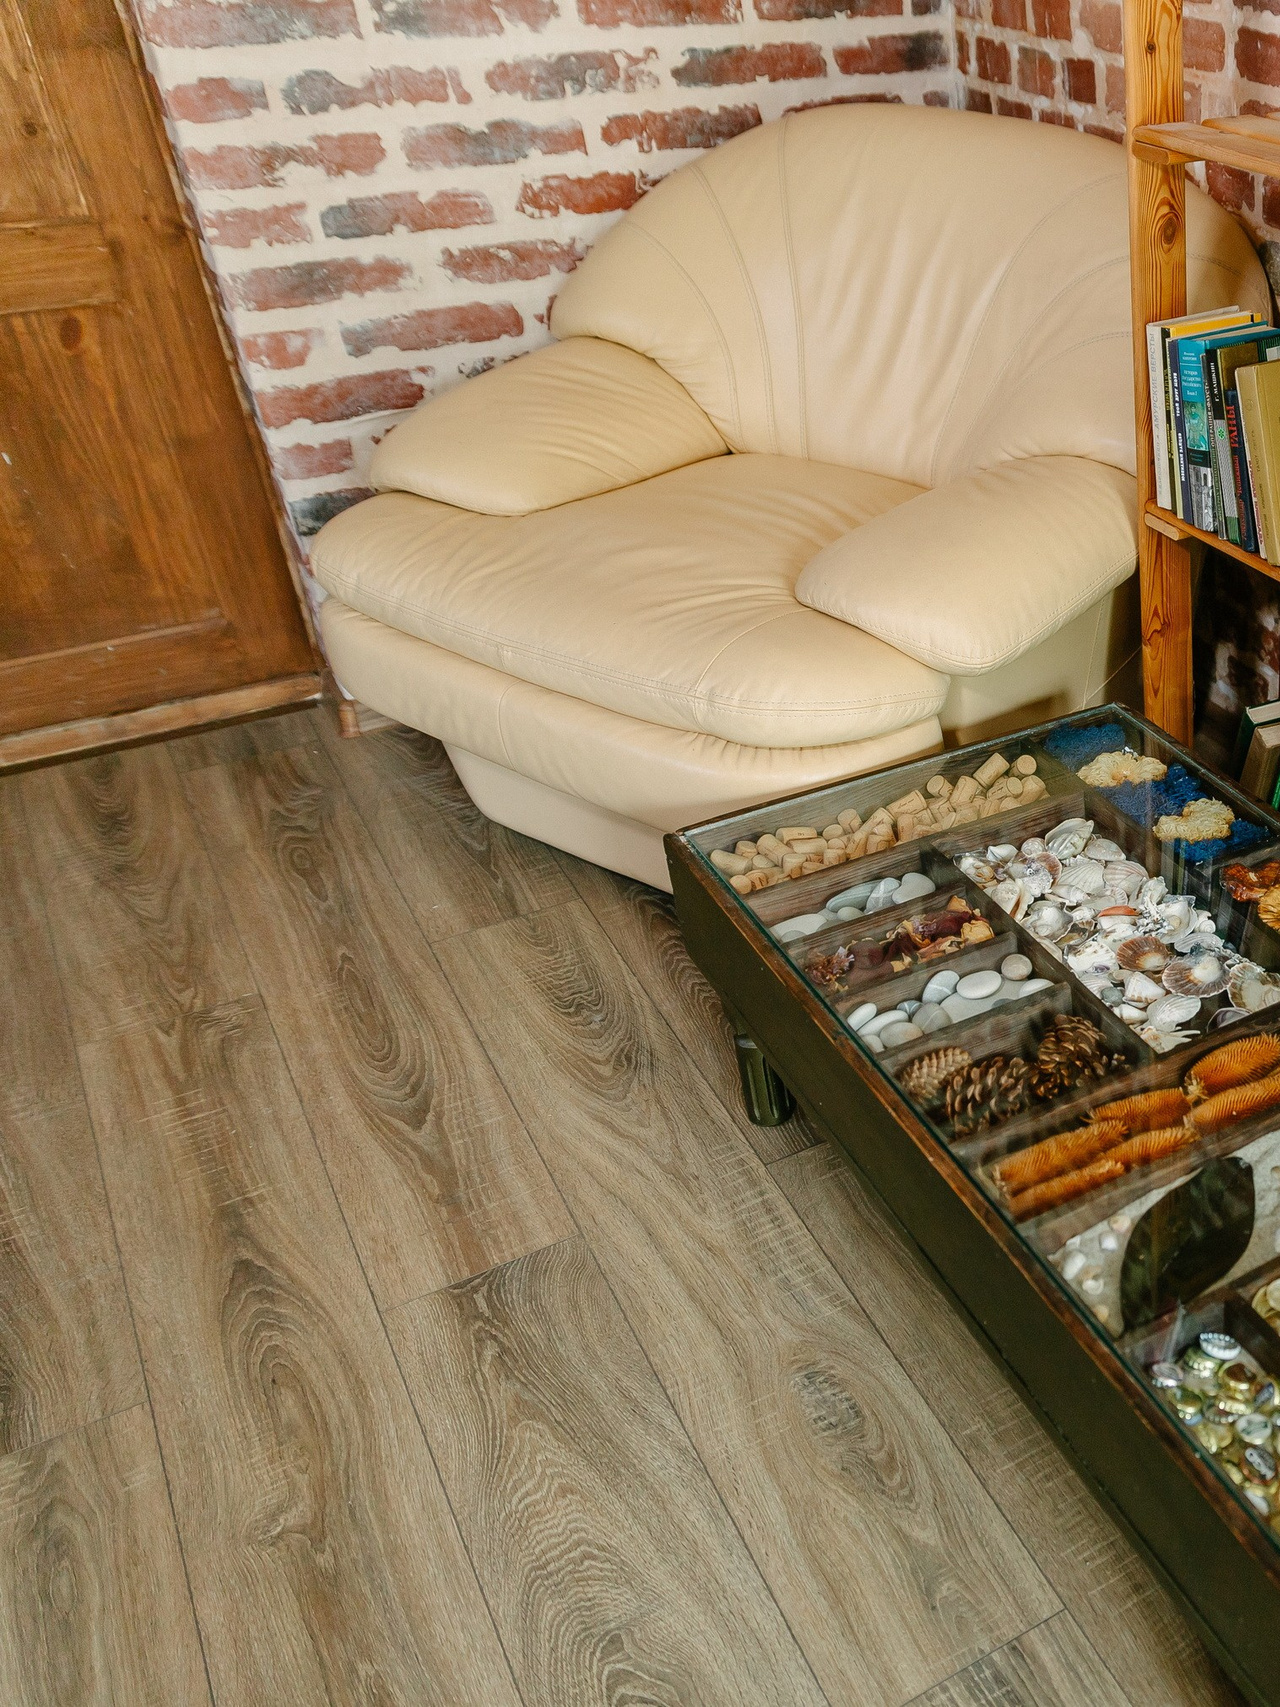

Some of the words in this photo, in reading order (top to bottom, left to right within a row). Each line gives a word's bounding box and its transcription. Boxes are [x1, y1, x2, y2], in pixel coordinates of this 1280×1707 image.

[1149, 333, 1157, 372] ВЕРСТЫ
[1152, 377, 1160, 429] АМУРСКИЕ
[1227, 405, 1239, 448] РАНЫ
